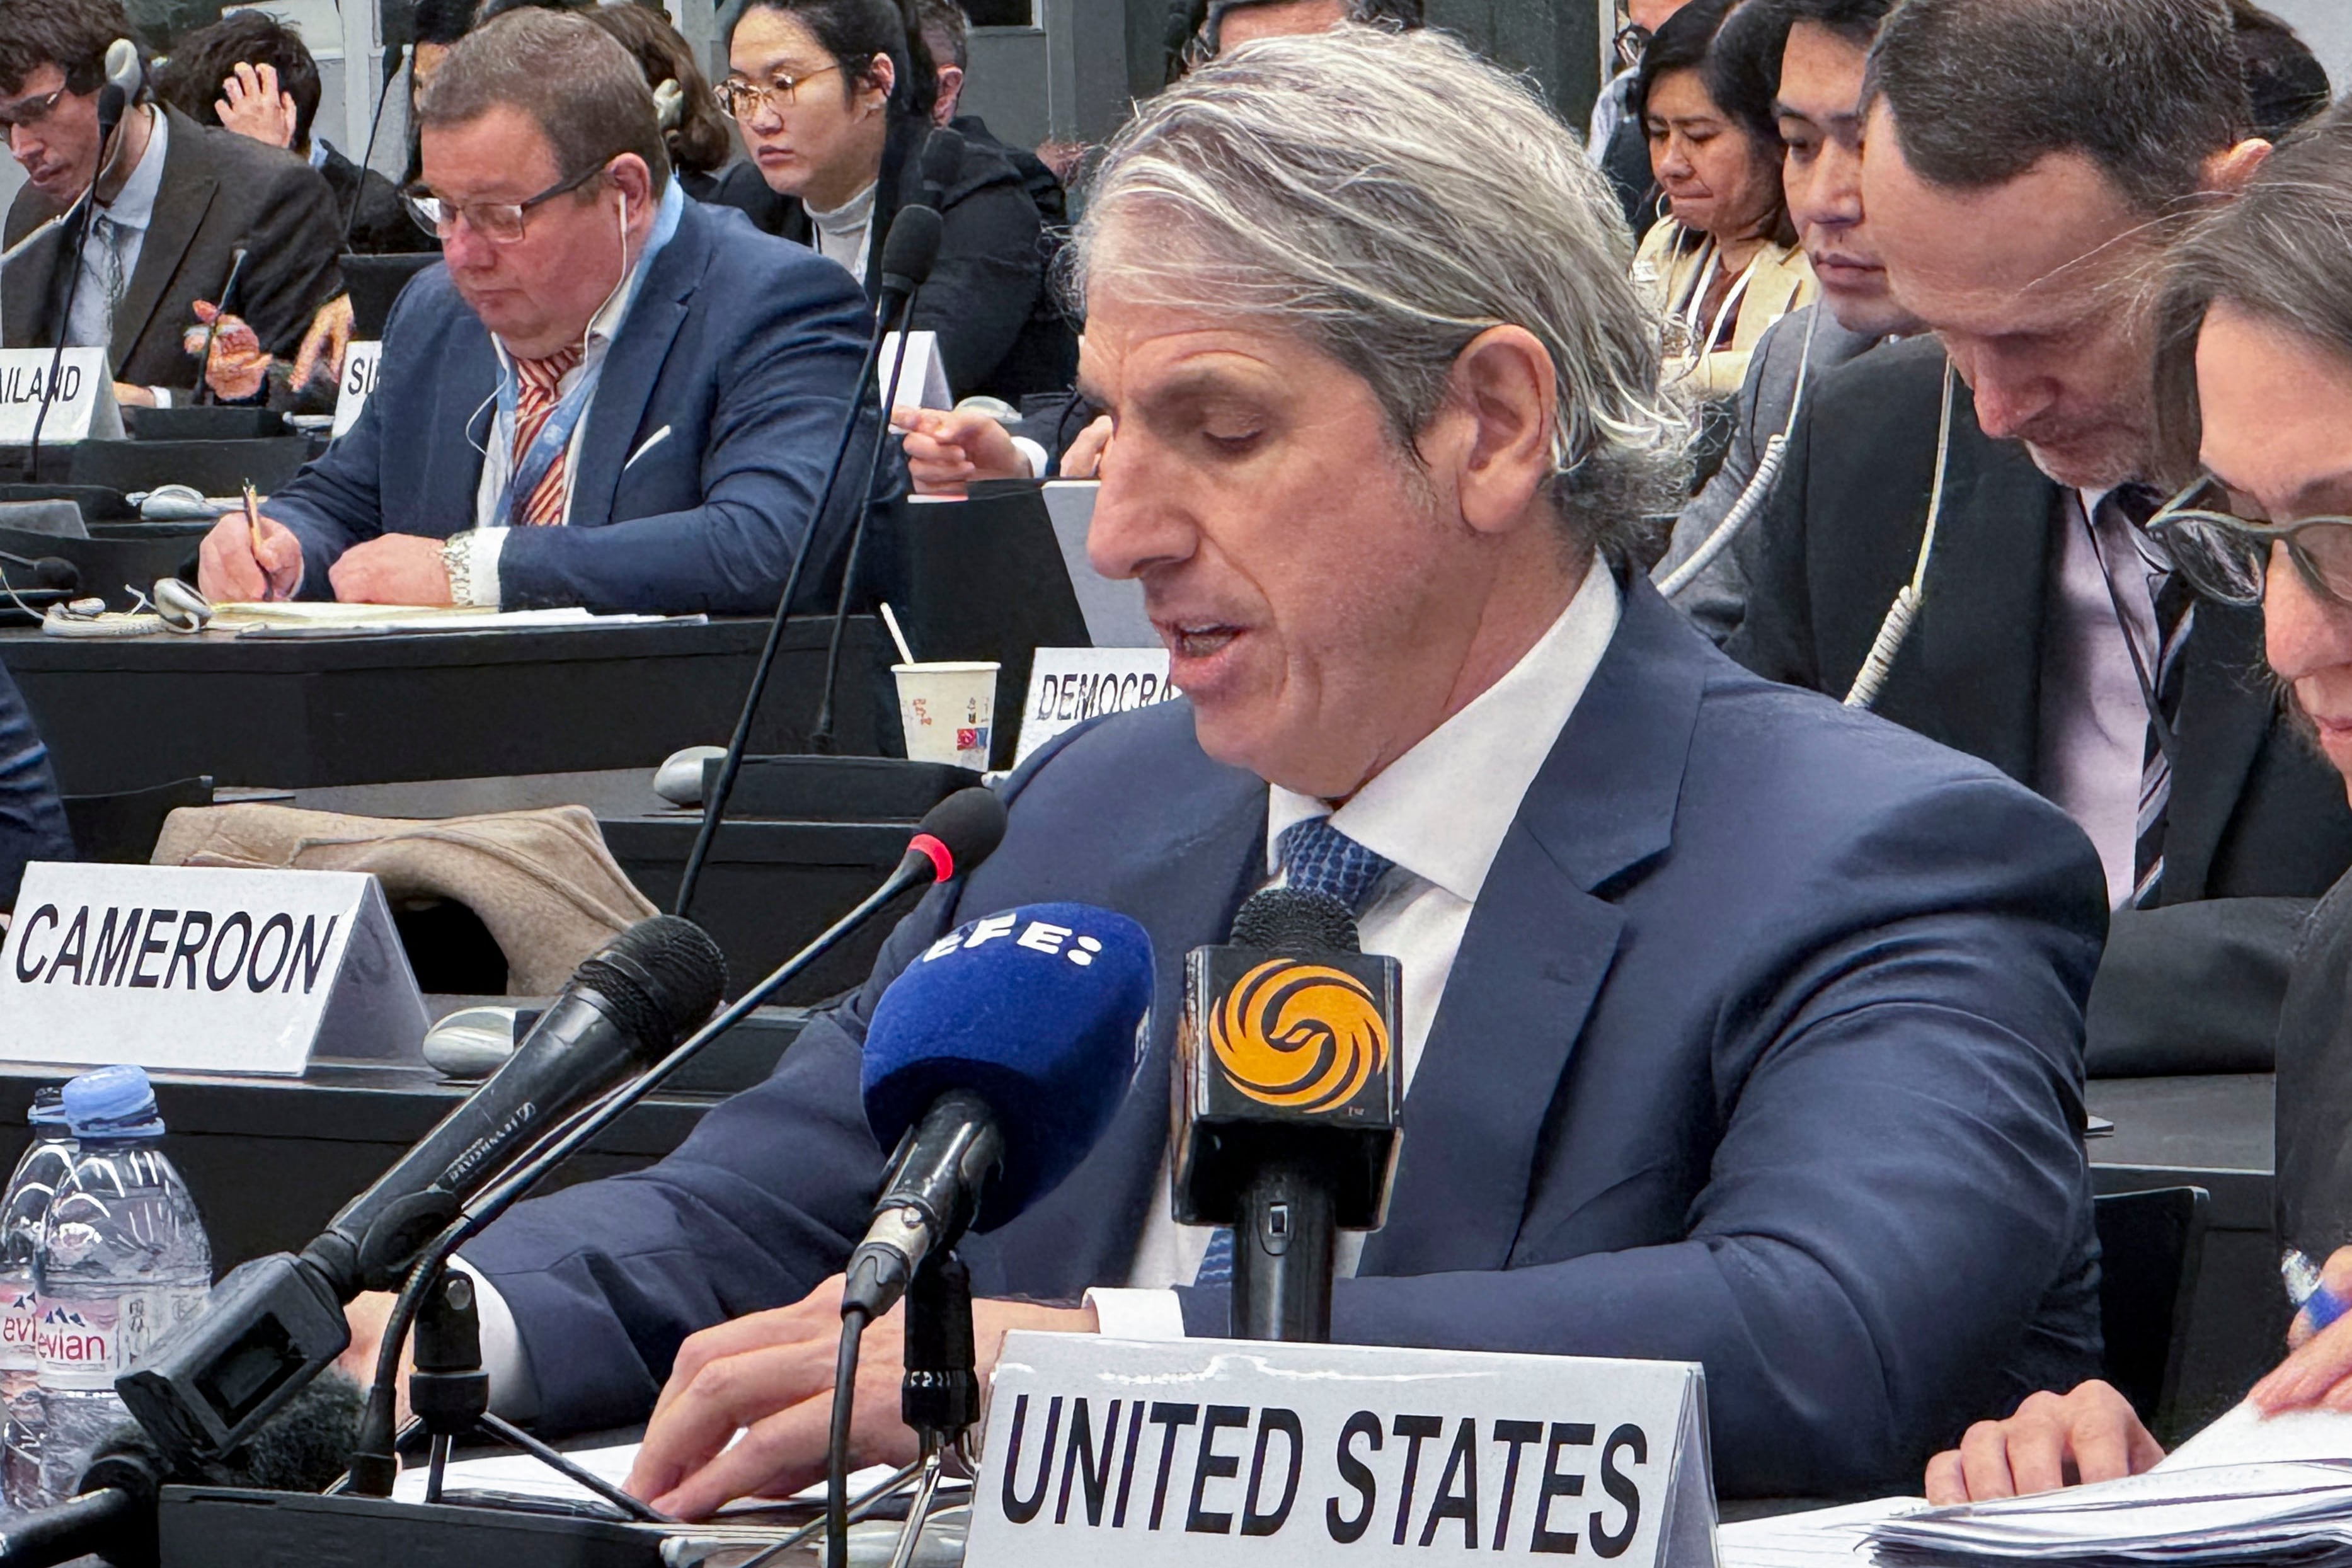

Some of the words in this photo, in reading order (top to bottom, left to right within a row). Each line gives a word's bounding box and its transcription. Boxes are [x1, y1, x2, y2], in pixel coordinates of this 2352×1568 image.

[0, 366, 81, 403] ILAND
[16, 903, 339, 994] CAMEROON
[38, 1327, 105, 1361] evian
[1002, 1394, 1304, 1537] UNITED
[1326, 1411, 1648, 1559] STATES
